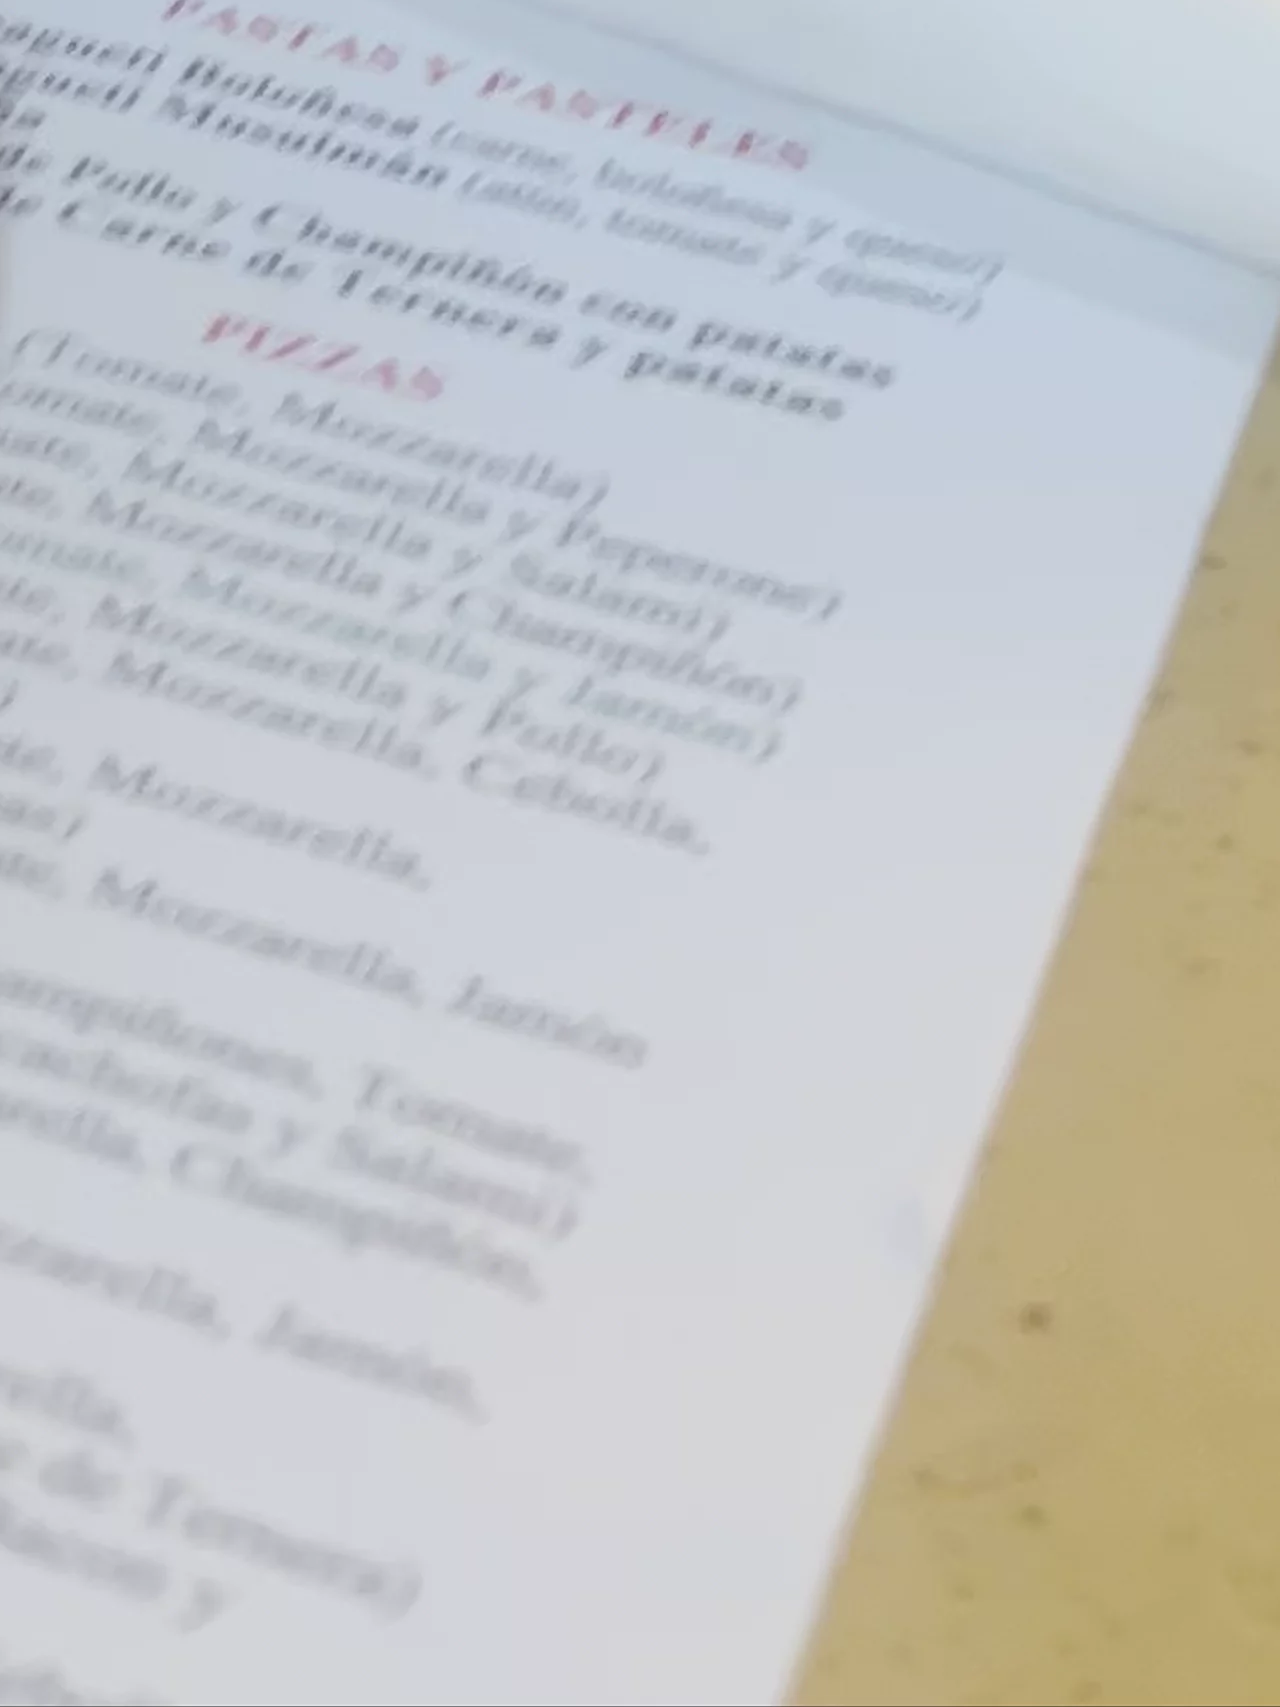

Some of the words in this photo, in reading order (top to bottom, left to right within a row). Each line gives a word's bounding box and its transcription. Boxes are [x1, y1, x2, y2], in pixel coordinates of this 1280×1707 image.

[169, 53, 424, 140] Boloñesa
[420, 51, 450, 86] Y
[477, 67, 812, 170] PASTELES
[56, 198, 231, 264] Carne
[243, 245, 313, 281] de
[332, 267, 563, 349] Ternera
[568, 330, 610, 379] y
[622, 346, 847, 429] patatas
[70, 155, 197, 208] Pollo
[204, 194, 241, 233] y
[249, 199, 570, 313] Champiñón
[579, 288, 676, 332] con
[687, 316, 898, 394] patatas
[201, 314, 445, 398] PIZZAS
[18, 330, 251, 421] (Tomate,
[270, 389, 611, 515] Mozzarella)
[192, 421, 491, 524] Mozzarella
[84, 493, 385, 594] Mozzarella
[122, 454, 420, 558] Mozzarella
[90, 595, 406, 707] Mozzarella
[183, 569, 492, 674] Mozzarella
